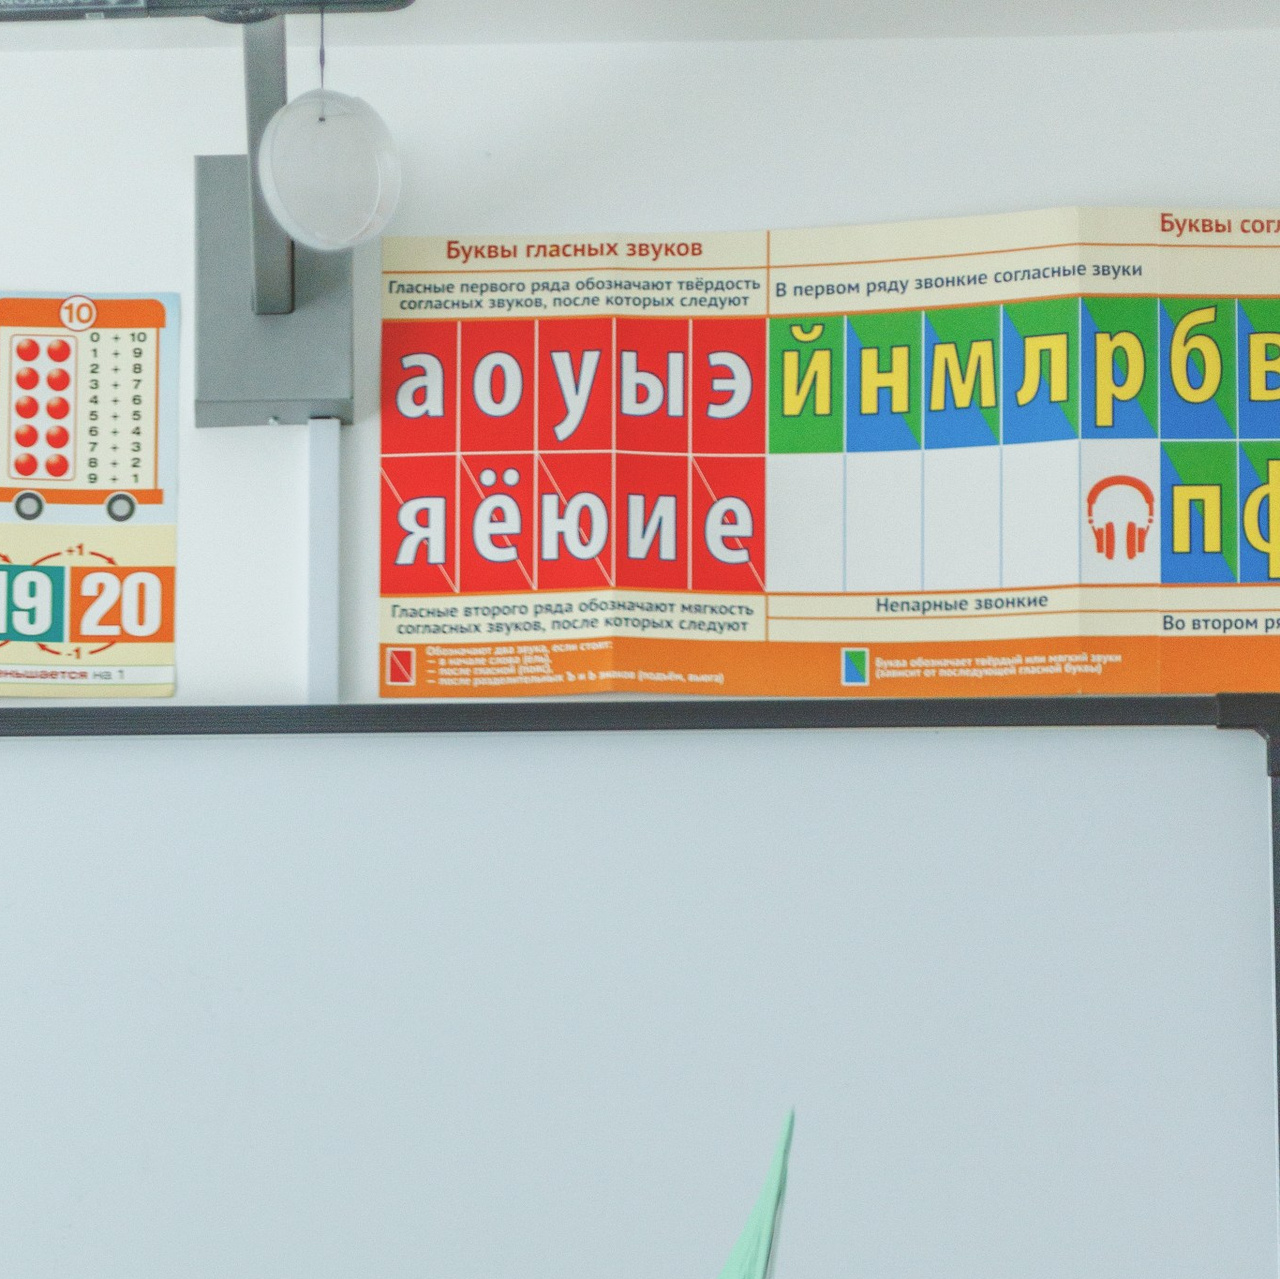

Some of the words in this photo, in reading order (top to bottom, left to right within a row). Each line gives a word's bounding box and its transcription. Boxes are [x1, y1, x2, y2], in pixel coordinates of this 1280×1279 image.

[1160, 213, 1232, 237] Буквы
[447, 240, 517, 264] Буквы
[526, 243, 619, 258] гласных
[626, 243, 703, 261] звуков
[388, 280, 455, 295] Гласные
[460, 281, 526, 296] первого
[531, 281, 570, 295] ряда
[575, 277, 673, 291] обозначают
[677, 277, 761, 293] твёрдость
[775, 282, 787, 297] В
[793, 282, 860, 299] первом
[866, 278, 909, 296] ряду
[915, 272, 988, 290] звонкие
[994, 264, 1087, 285] согласные
[1092, 264, 1142, 280] звуки
[63, 303, 93, 324] 10
[400, 297, 484, 311] согласных
[488, 297, 547, 312] звуков,
[553, 295, 601, 308] после
[605, 295, 674, 310] которых
[680, 295, 750, 310] следуют
[782, 323, 833, 417] й
[860, 345, 910, 416] н
[930, 339, 998, 412] м
[1015, 332, 1070, 407] л
[1094, 330, 1147, 428] р
[1169, 306, 1222, 404] б
[396, 351, 445, 419] а
[473, 351, 524, 419] о
[550, 349, 601, 442] у
[620, 350, 685, 418] ы
[706, 351, 752, 419] э
[394, 496, 446, 565] я
[473, 467, 522, 563] ё
[541, 492, 609, 561] ю
[627, 493, 677, 561] и
[704, 495, 754, 564] е
[1173, 484, 1222, 554] п
[79, 571, 163, 637] 20
[391, 604, 459, 618] Гласные
[464, 604, 528, 619] второго
[534, 602, 573, 617] ряда
[579, 598, 676, 613] обозначают
[681, 603, 754, 616] мягкость
[876, 597, 969, 615] Непарные
[975, 594, 1049, 610] звонкие
[397, 622, 481, 635] согласных
[486, 620, 546, 636] звуков,
[552, 617, 599, 631] после
[604, 616, 673, 631] которых
[679, 618, 748, 634] следуют
[1163, 615, 1186, 631] Во
[1192, 617, 1258, 633] втором
[93, 670, 113, 681] на
